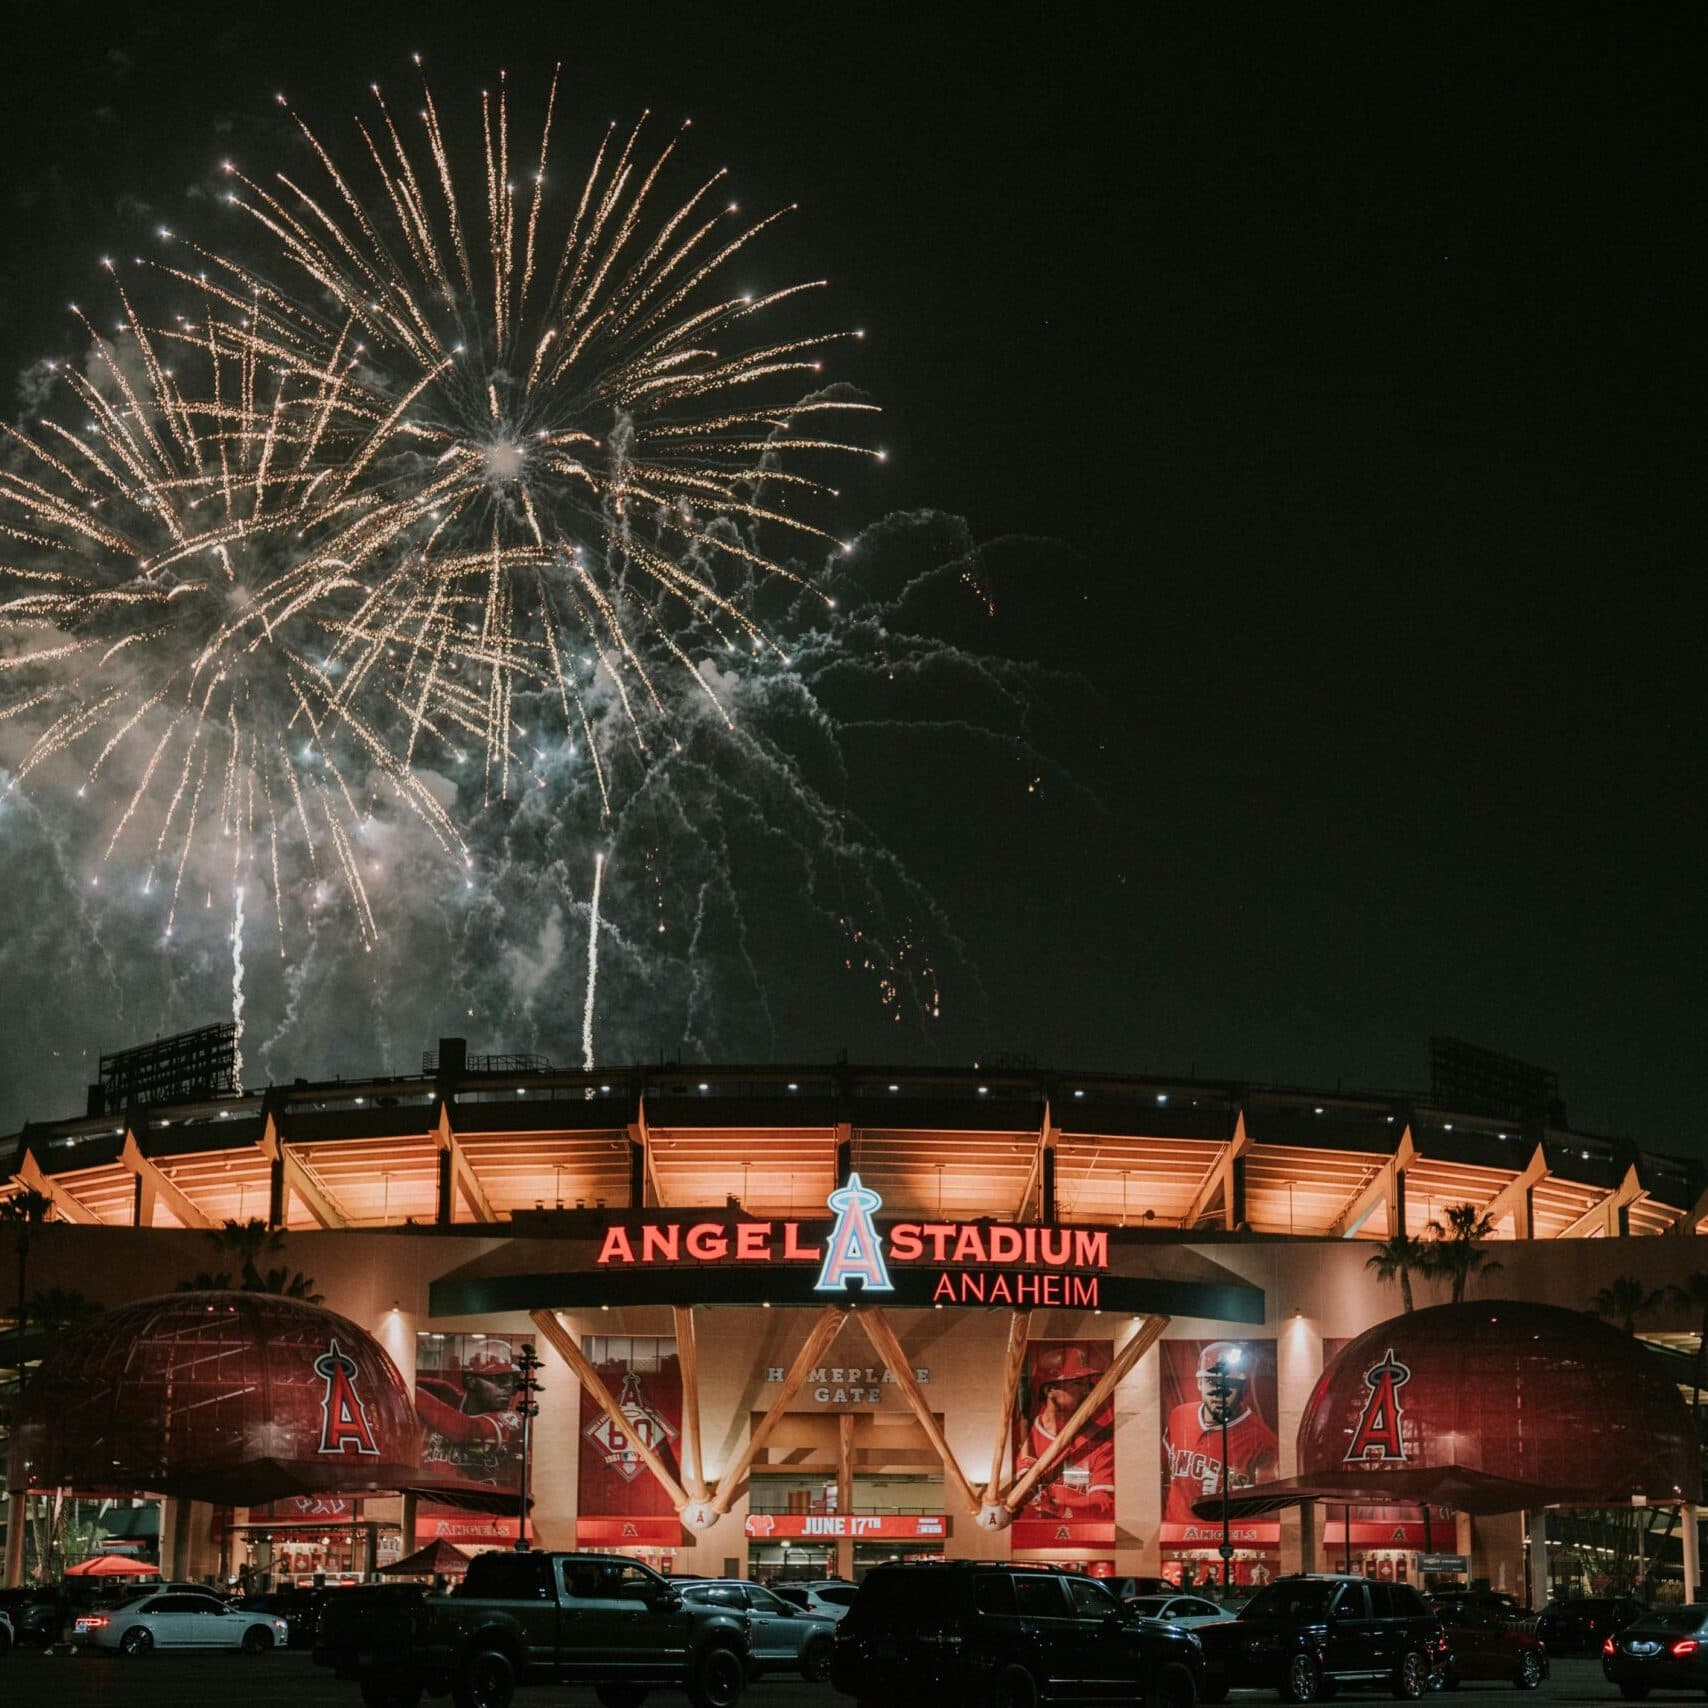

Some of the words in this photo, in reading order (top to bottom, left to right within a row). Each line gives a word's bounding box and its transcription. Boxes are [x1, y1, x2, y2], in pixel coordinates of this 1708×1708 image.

[597, 1221, 820, 1264] ANGEL
[813, 1172, 895, 1291] A
[890, 1222, 1109, 1268] STADIUM
[933, 1272, 1100, 1307] ANAHEIM
[767, 1367, 930, 1383] HMEPLAE
[814, 1388, 881, 1403] GATE
[801, 1516, 846, 1535] JUNE
[851, 1516, 881, 1535] 17TH
